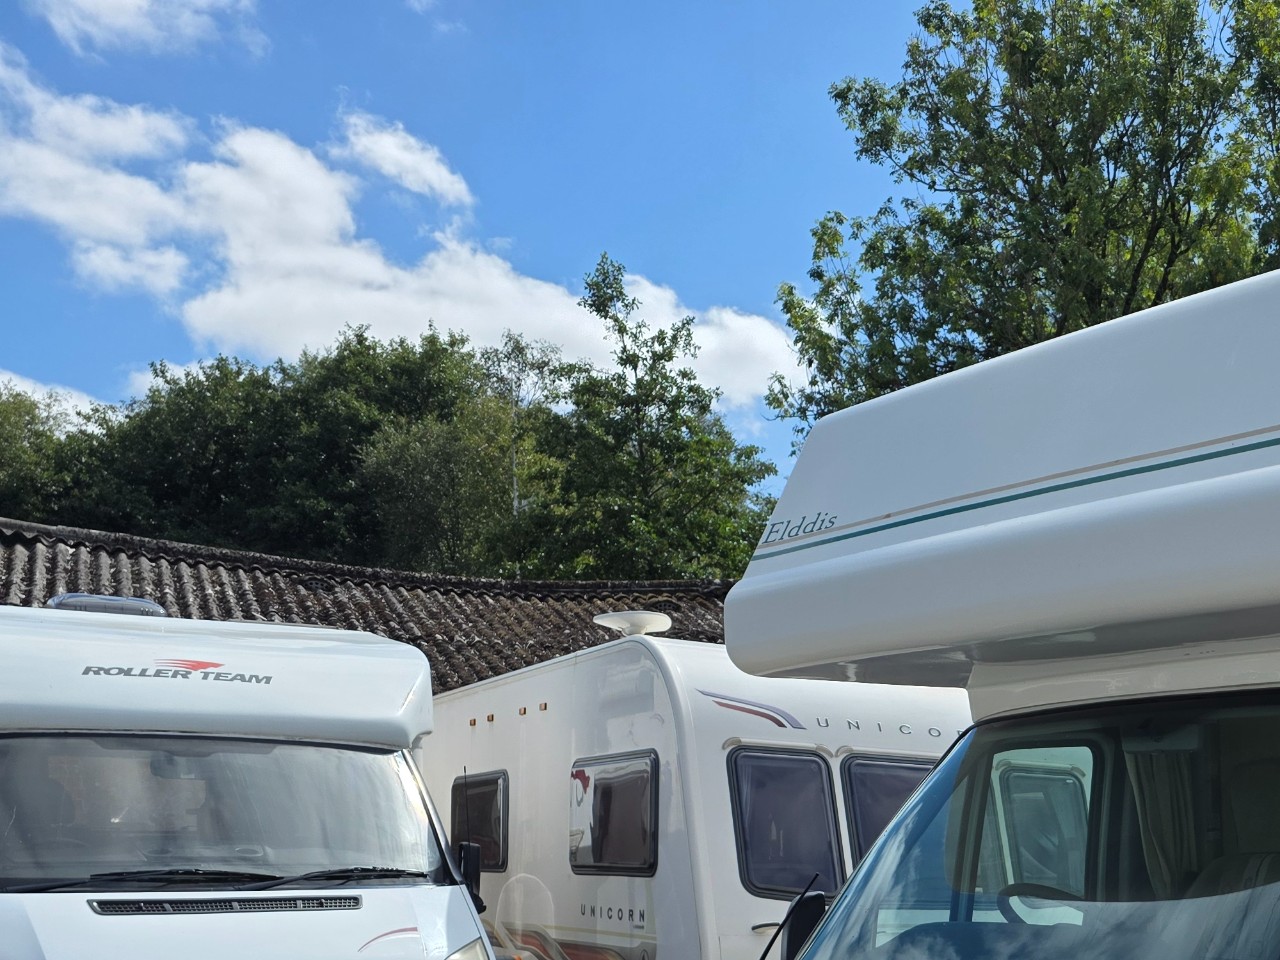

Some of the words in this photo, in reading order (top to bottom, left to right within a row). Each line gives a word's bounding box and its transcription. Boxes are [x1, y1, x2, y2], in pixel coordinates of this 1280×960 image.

[761, 511, 838, 544] Elddis
[81, 666, 192, 679] ROLLER
[200, 671, 273, 685] TEAM
[580, 904, 645, 922] UNICORN
